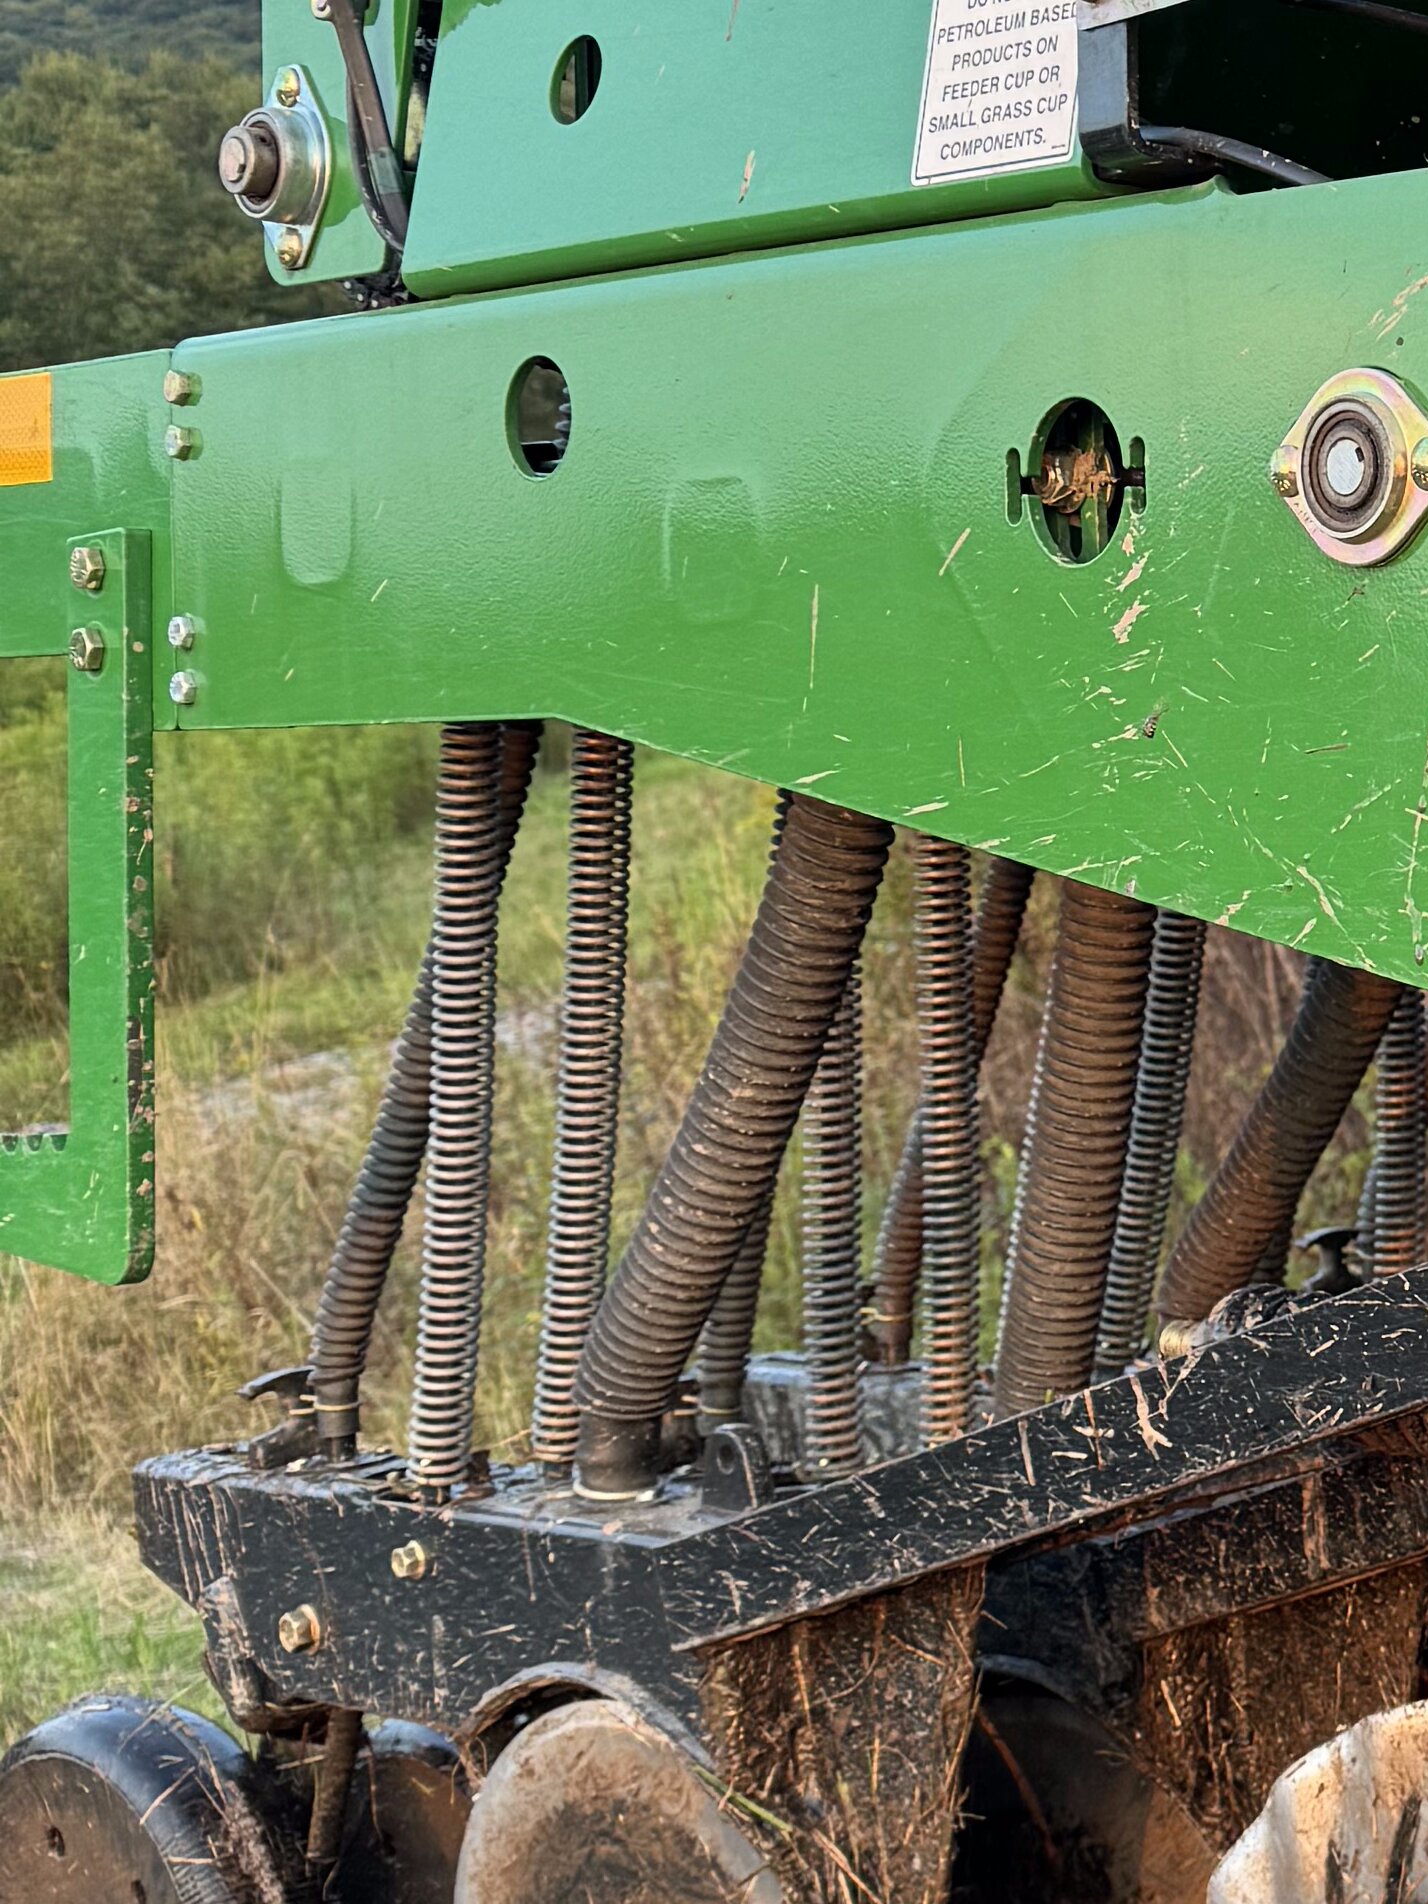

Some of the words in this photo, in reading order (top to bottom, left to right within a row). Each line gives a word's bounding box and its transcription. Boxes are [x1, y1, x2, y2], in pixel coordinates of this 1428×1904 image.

[937, 10, 1026, 45] PETROLEUM
[951, 39, 1032, 72] PRODUCTS
[1036, 34, 1059, 54] ON
[942, 75, 1000, 103] FEEDER
[1003, 70, 1035, 92] CUP
[1038, 64, 1061, 85] OR
[928, 109, 977, 134] SMALL
[980, 98, 1033, 125] GRASS
[1036, 93, 1069, 115] CUP
[940, 126, 1047, 161] COMPONENTS.
